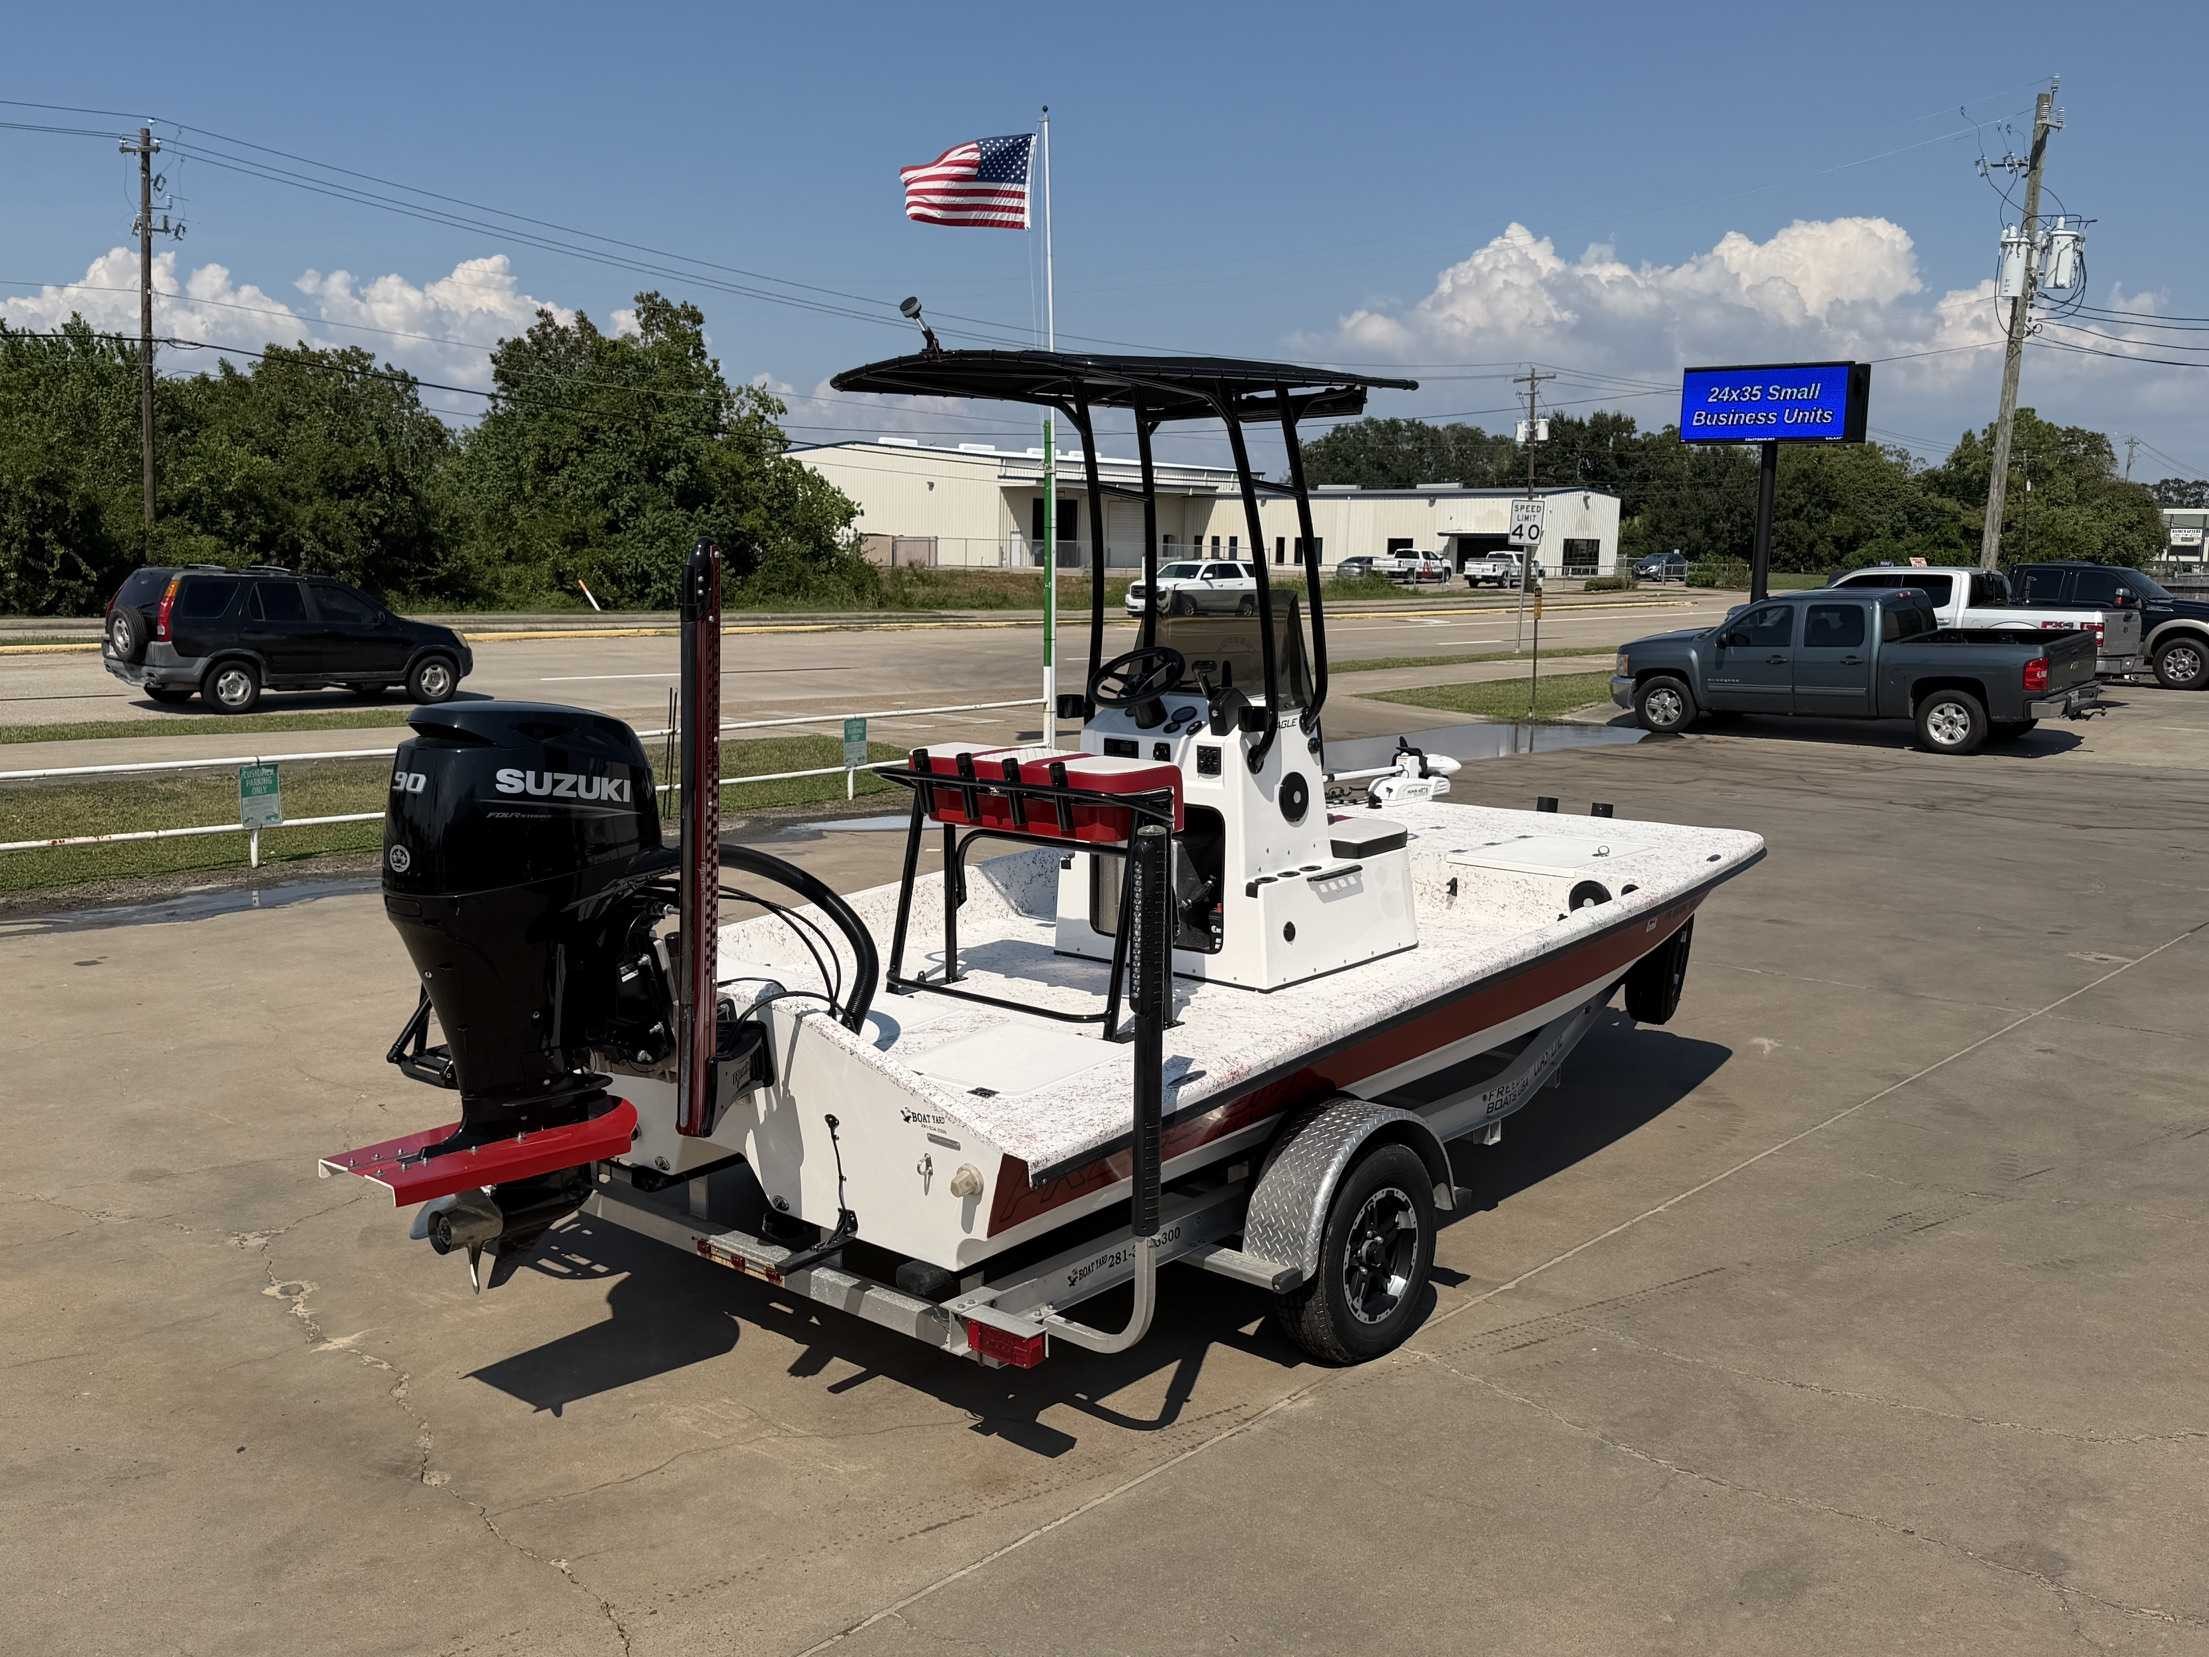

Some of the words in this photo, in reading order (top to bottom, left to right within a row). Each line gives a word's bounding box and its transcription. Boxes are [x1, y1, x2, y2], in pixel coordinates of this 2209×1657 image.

[1708, 386, 1762, 402] 24x35
[1767, 383, 1821, 401] Small
[1693, 409, 1777, 426] Business
[1784, 407, 1833, 424] Units
[1514, 504, 1541, 512] SPEED
[1517, 514, 1537, 522] LIMIT
[1511, 524, 1540, 540] 40
[392, 771, 427, 794] 90
[496, 768, 631, 803] SUZUKI
[911, 1111, 930, 1123] BOAT
